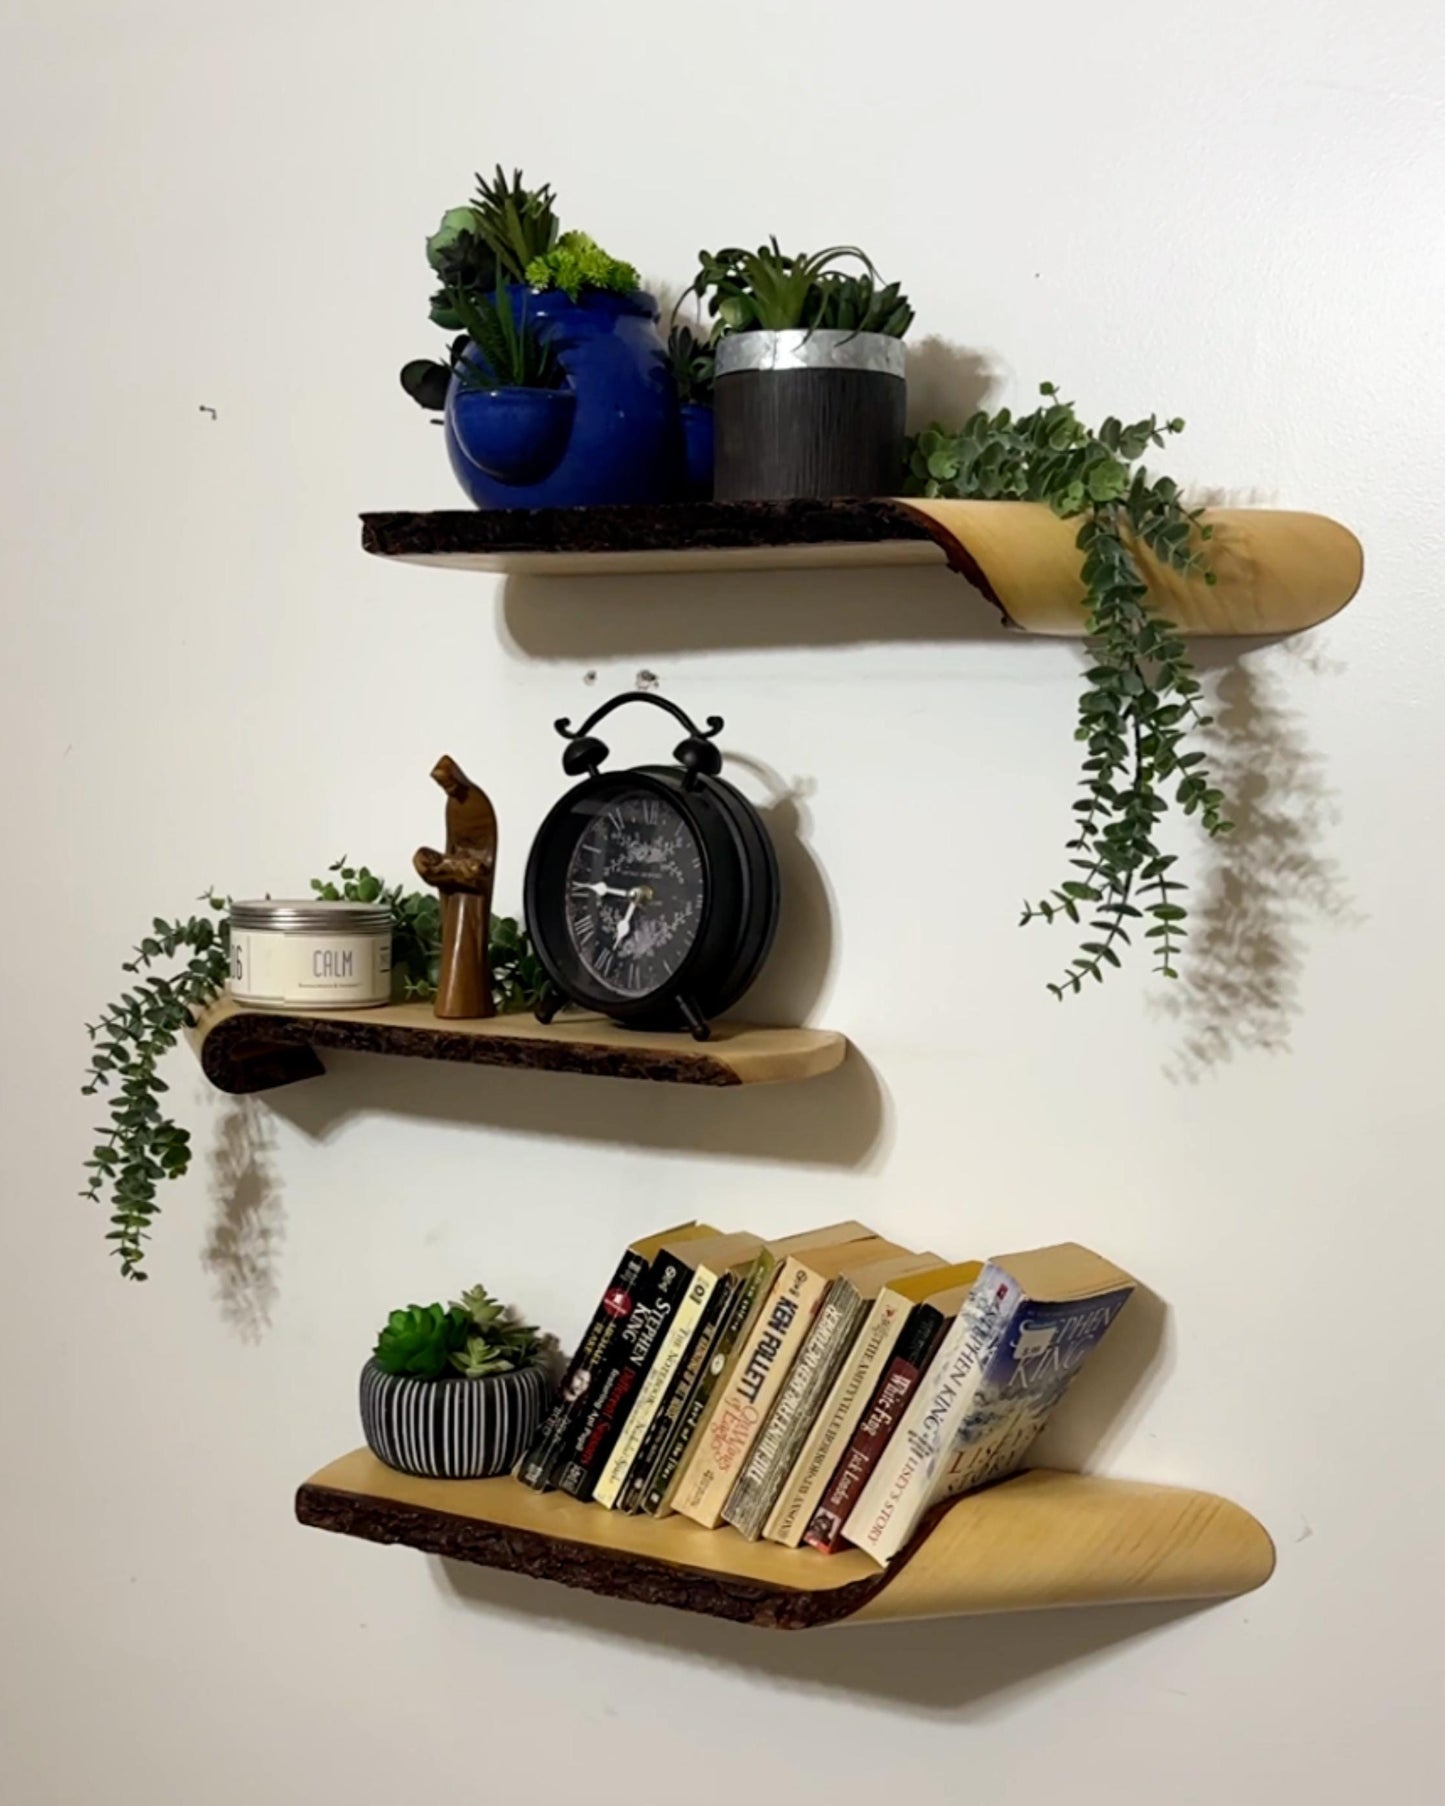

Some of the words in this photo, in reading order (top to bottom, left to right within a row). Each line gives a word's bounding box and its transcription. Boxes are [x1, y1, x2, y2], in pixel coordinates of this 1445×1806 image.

[312, 950, 353, 977] CALM
[620, 1300, 652, 1345] KING
[627, 1296, 672, 1368] STEPHEN
[766, 1295, 799, 1334] KEN
[801, 1302, 843, 1369] OCTOBER
[733, 1329, 783, 1404] FOLLETT
[862, 1335, 883, 1361] THE
[1008, 1338, 1087, 1388] KING
[601, 1365, 637, 1420] Different
[788, 1361, 813, 1395] RED
[829, 1359, 871, 1429] AMITYVILLE
[876, 1372, 912, 1412] White
[584, 1408, 601, 1428] Apt
[685, 1401, 705, 1425] lord
[775, 1388, 801, 1421] FOR
[858, 1405, 894, 1440] Fang
[921, 1381, 958, 1436] KING
[574, 1426, 593, 1452] Pupil
[579, 1418, 612, 1468] Seasons
[678, 1428, 692, 1441] of
[702, 1406, 741, 1455] Eagles
[710, 1420, 752, 1474] Wings
[757, 1413, 788, 1459] HUNT
[806, 1428, 837, 1476] HORROR
[745, 1451, 771, 1484] THE
[842, 1446, 871, 1474] Jack
[887, 1455, 919, 1504] LISEY'S
[829, 1469, 861, 1508] London
[865, 1499, 896, 1546] STORY
